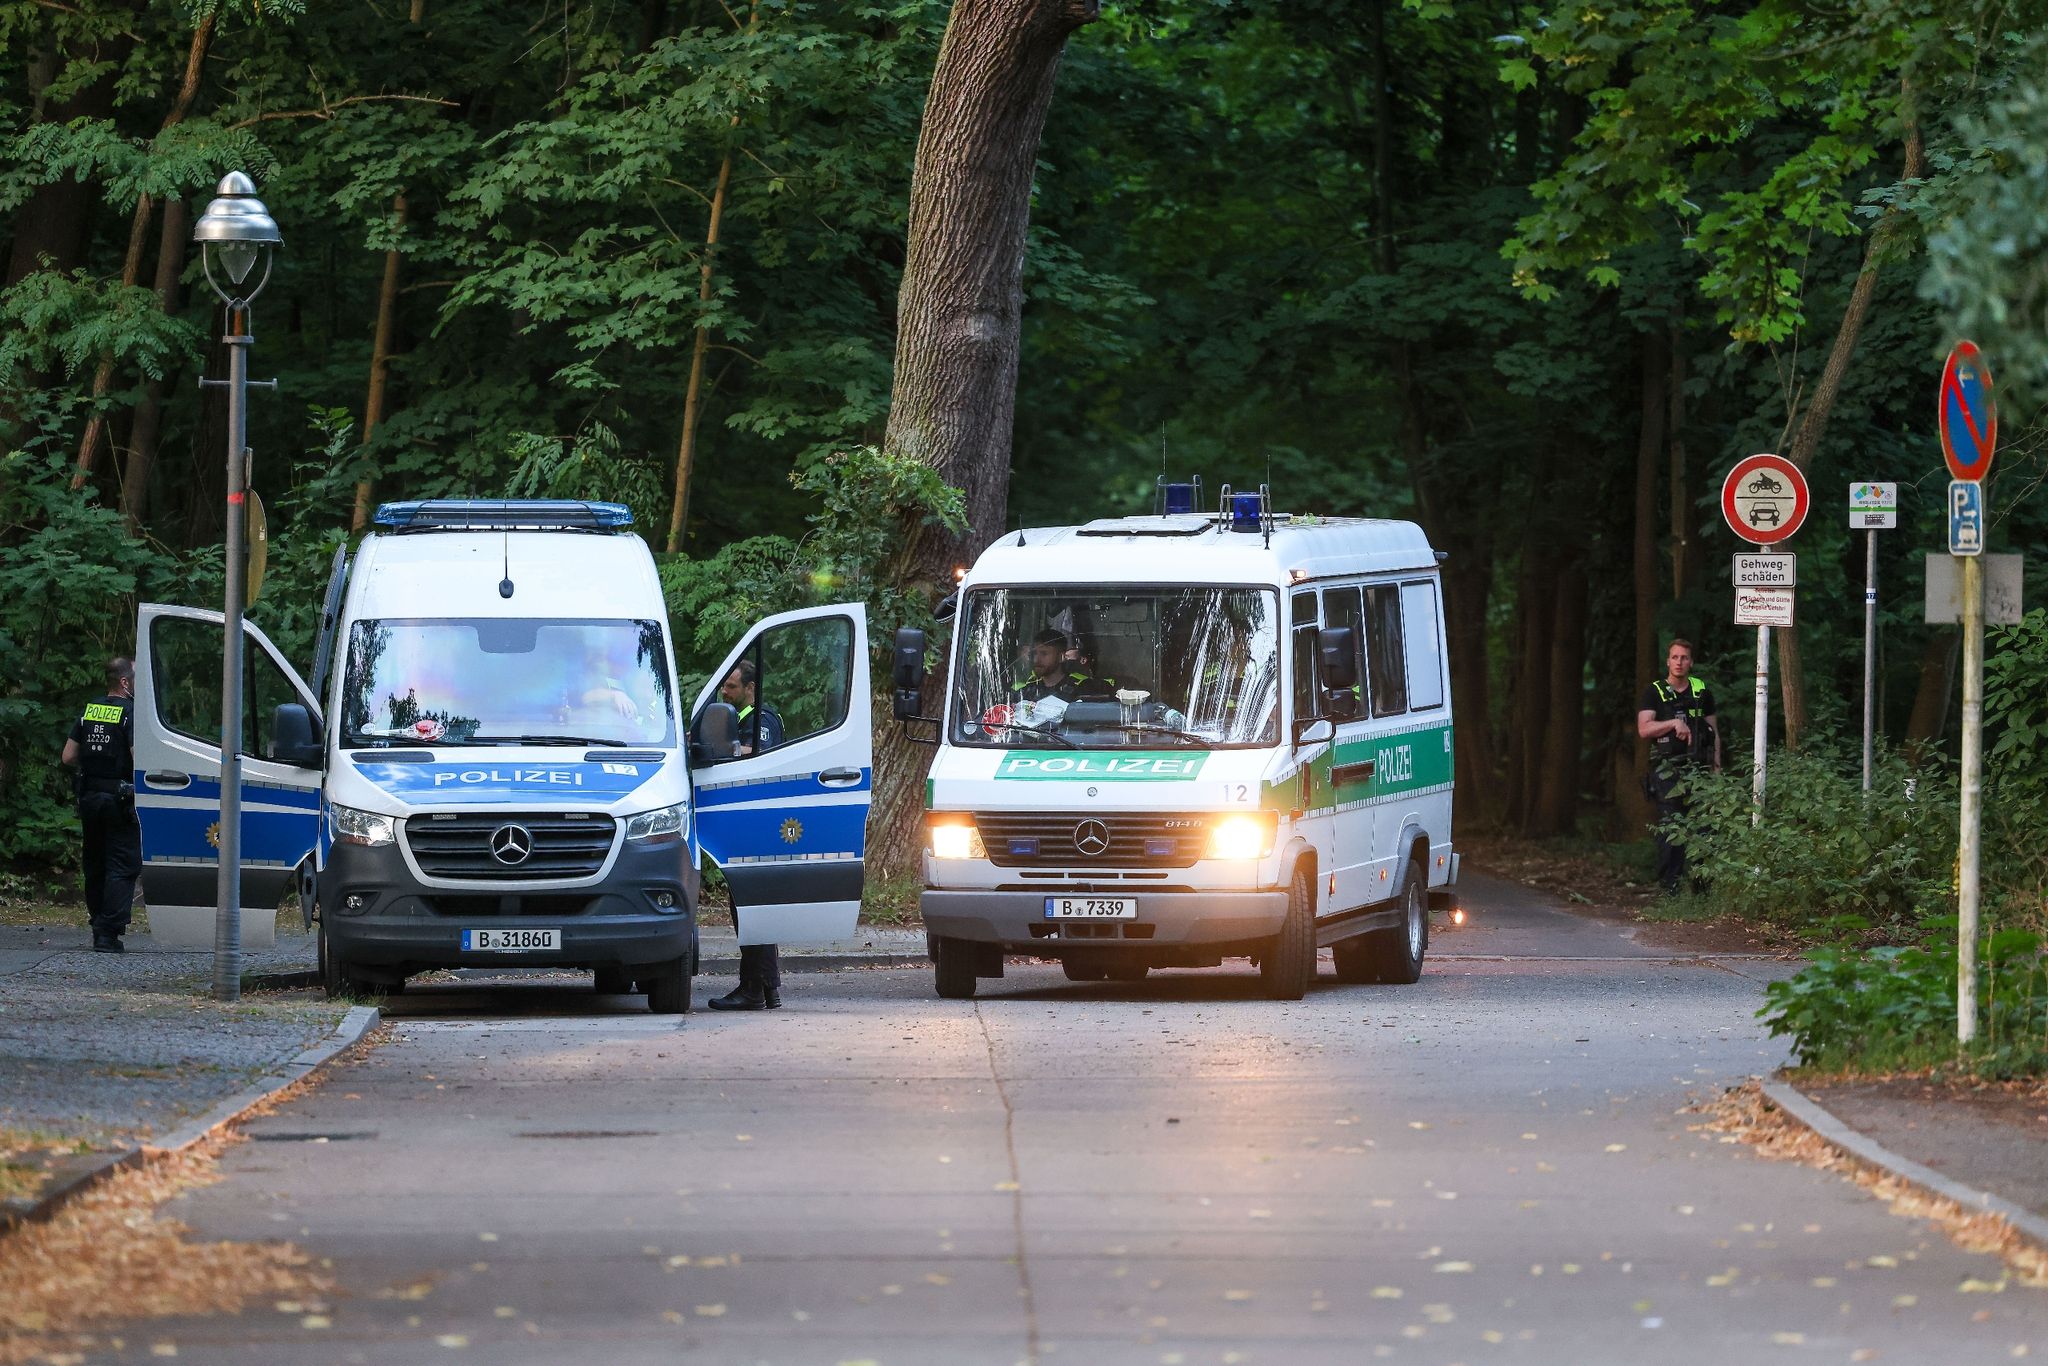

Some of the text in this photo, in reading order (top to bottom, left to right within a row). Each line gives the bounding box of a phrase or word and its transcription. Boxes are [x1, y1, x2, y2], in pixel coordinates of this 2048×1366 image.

[1954, 488, 1968, 519] P
[1741, 559, 1788, 571] Gehweg-
[1741, 570, 1785, 582] schäden
[86, 705, 121, 721] POLIZEI
[94, 725, 105, 733] BE
[1007, 758, 1196, 774] POLIZEI
[1378, 745, 1412, 784] POLIZEI
[434, 770, 582, 786] POLIZEI
[1063, 901, 1124, 915] B 7339
[480, 932, 551, 947] B 31860
